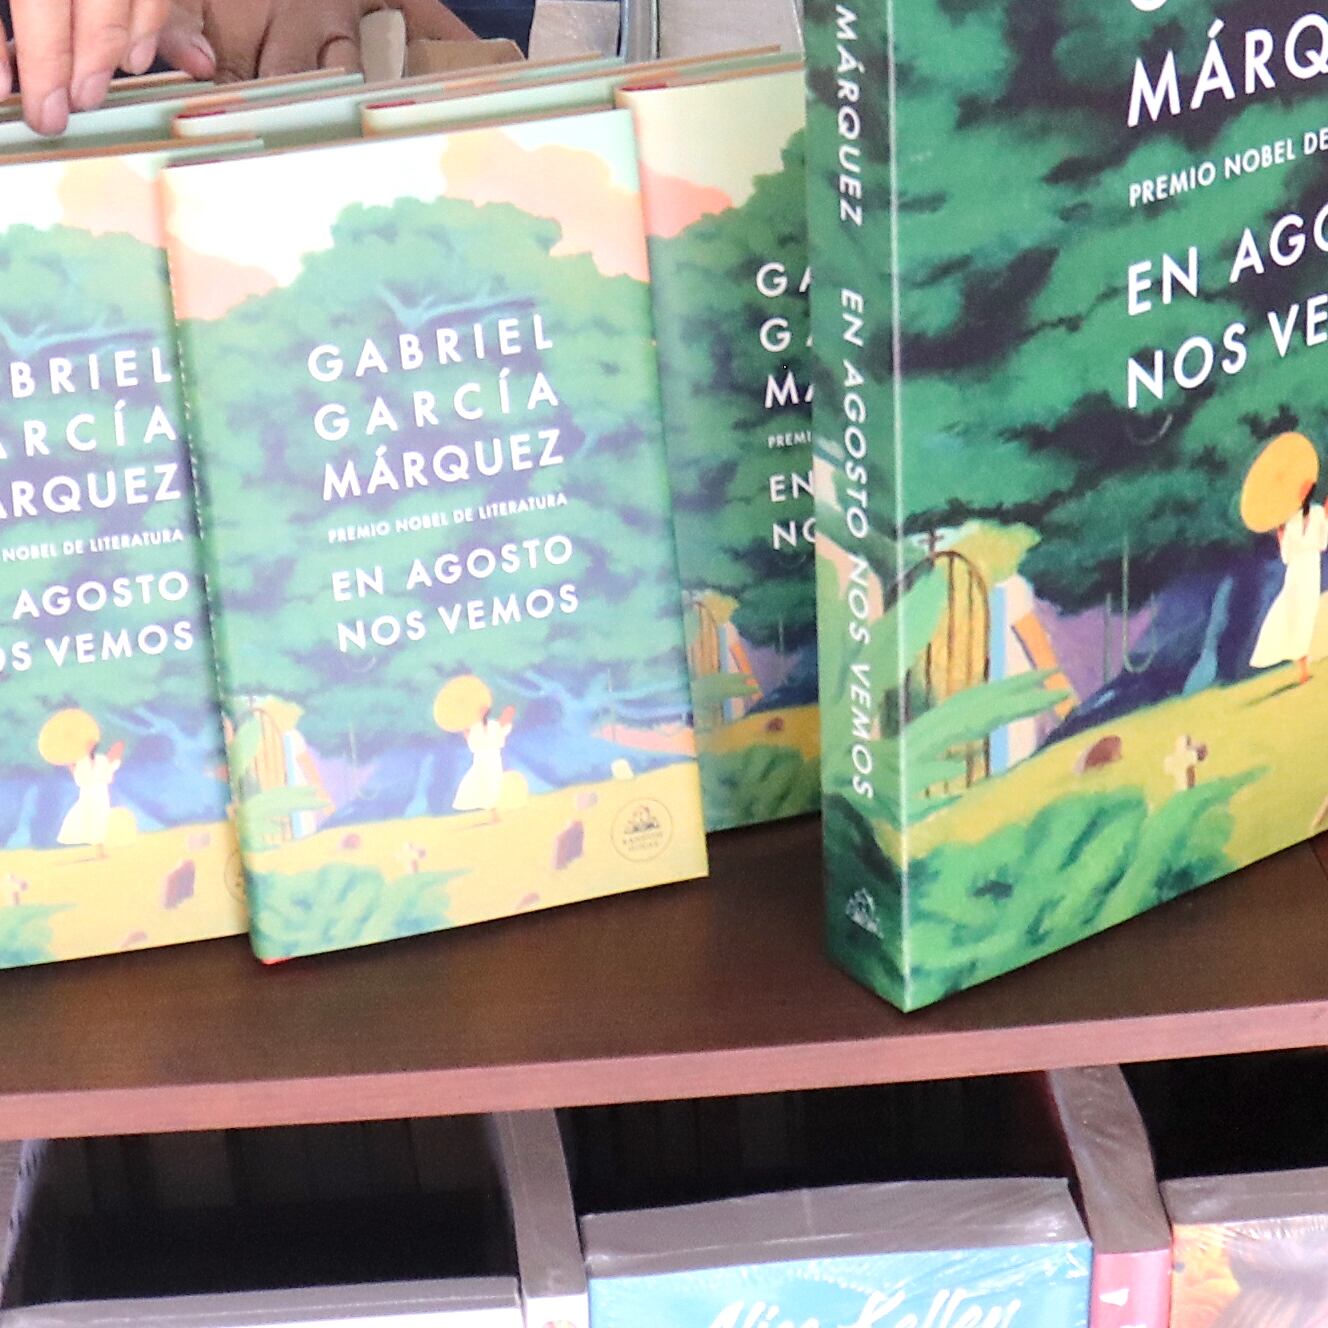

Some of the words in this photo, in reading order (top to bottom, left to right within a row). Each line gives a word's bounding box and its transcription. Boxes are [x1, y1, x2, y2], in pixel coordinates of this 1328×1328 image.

[834, 4, 863, 226] MÁRQUEZ
[1129, 162, 1216, 207] PREMIO
[1223, 142, 1296, 179] NOBEL
[1128, 246, 1198, 316] EN
[307, 314, 553, 382] GABRIEL
[840, 286, 864, 347] EN
[1128, 321, 1248, 409] NOS
[313, 368, 558, 441] GARCÍA
[323, 429, 563, 501] MÁRQUEZ
[844, 359, 869, 538] AGOSTO
[12, 572, 188, 619] AGOSTO
[332, 566, 385, 601] EN
[406, 535, 572, 590] AGOSTO
[847, 553, 872, 645] NOS
[45, 621, 194, 666] VEMOS
[337, 611, 426, 653] NOS
[438, 584, 579, 635] VEMOS
[850, 663, 874, 799] VEMOS
